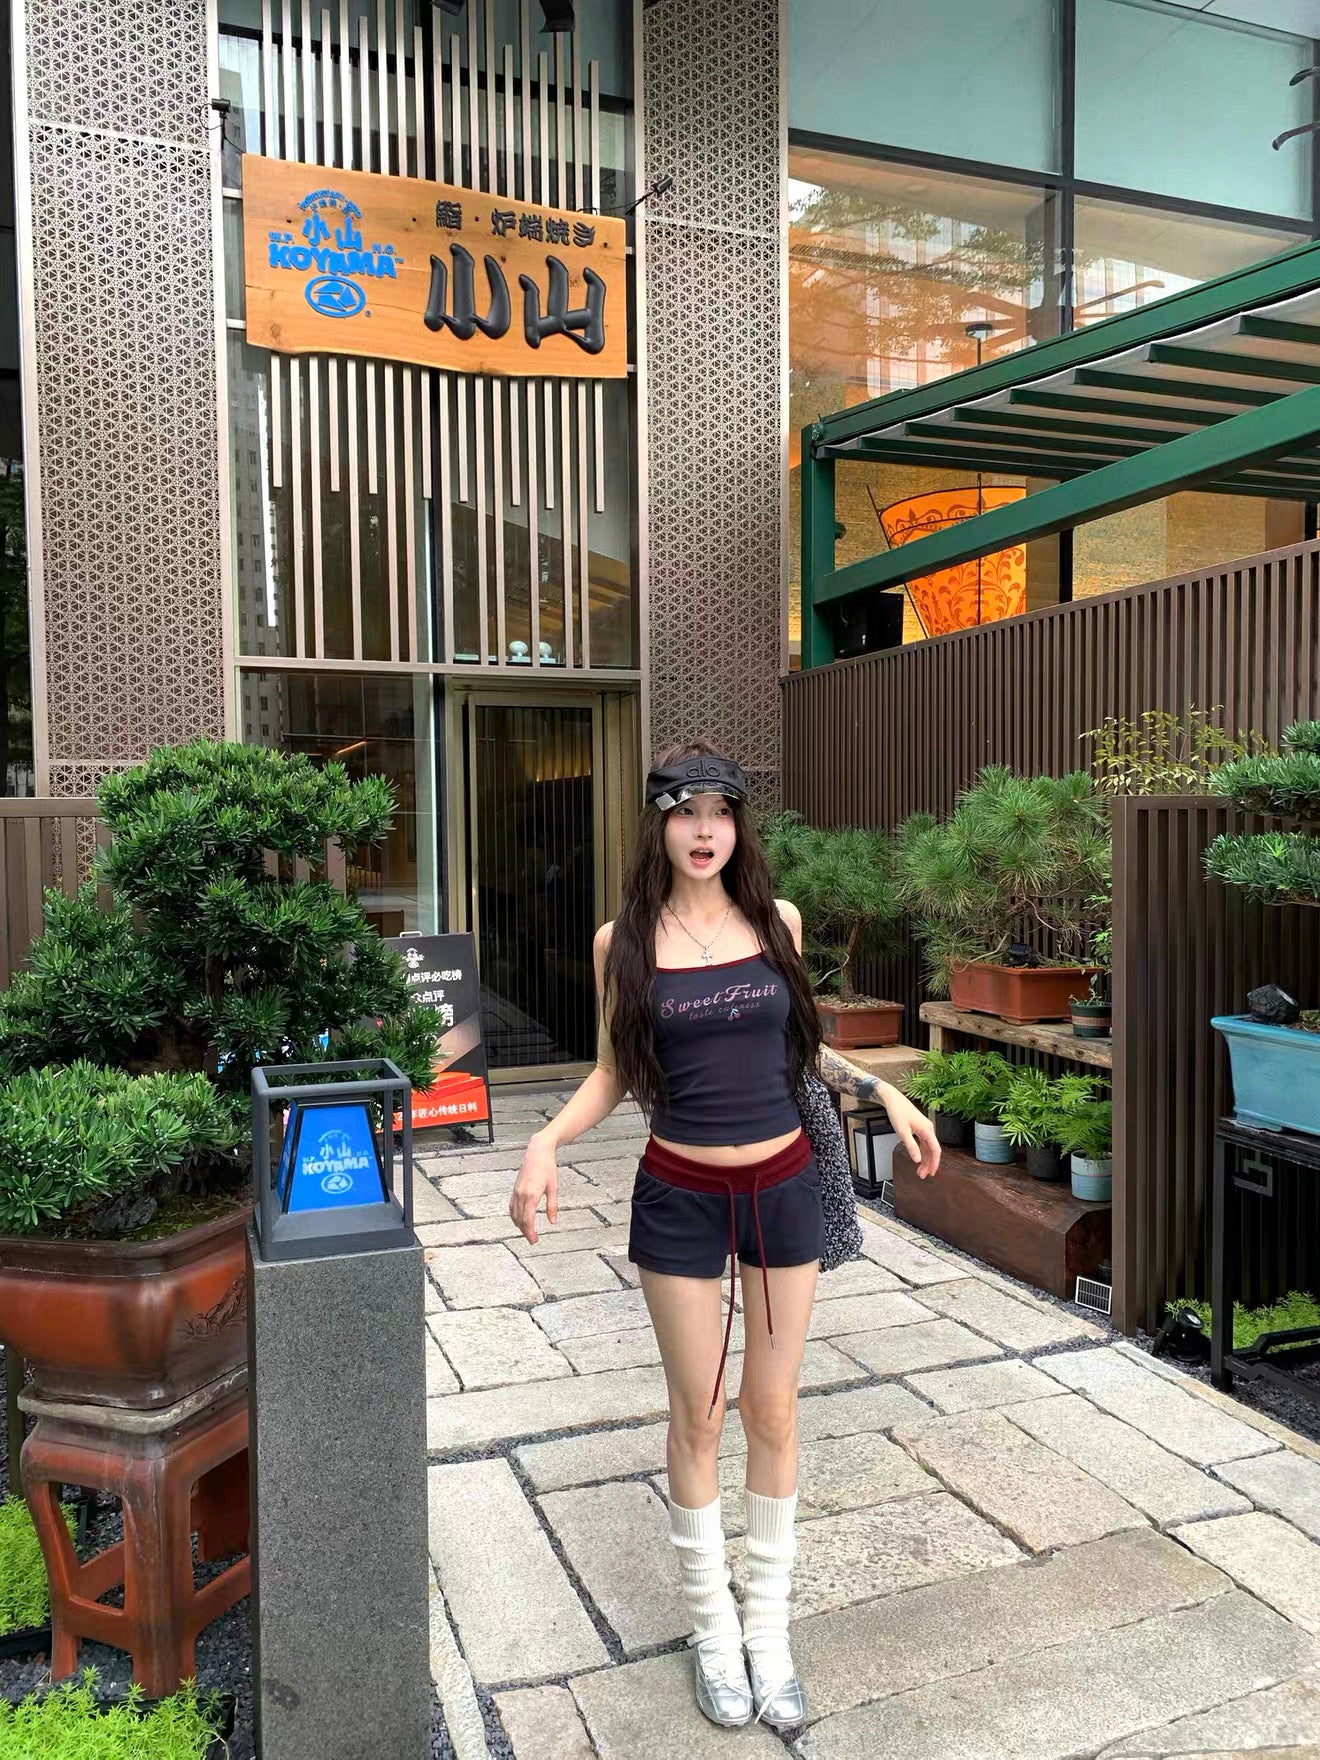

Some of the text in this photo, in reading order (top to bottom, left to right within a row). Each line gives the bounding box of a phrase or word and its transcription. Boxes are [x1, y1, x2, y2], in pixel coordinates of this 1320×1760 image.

[302, 212, 363, 251] 小山
[268, 242, 397, 279] KOYAMA
[424, 243, 606, 354] 小山
[686, 760, 720, 778] alo
[660, 983, 778, 1019] Sweet Fruit
[302, 1156, 370, 1176] KOYAMA
[319, 1142, 352, 1160] 小山
